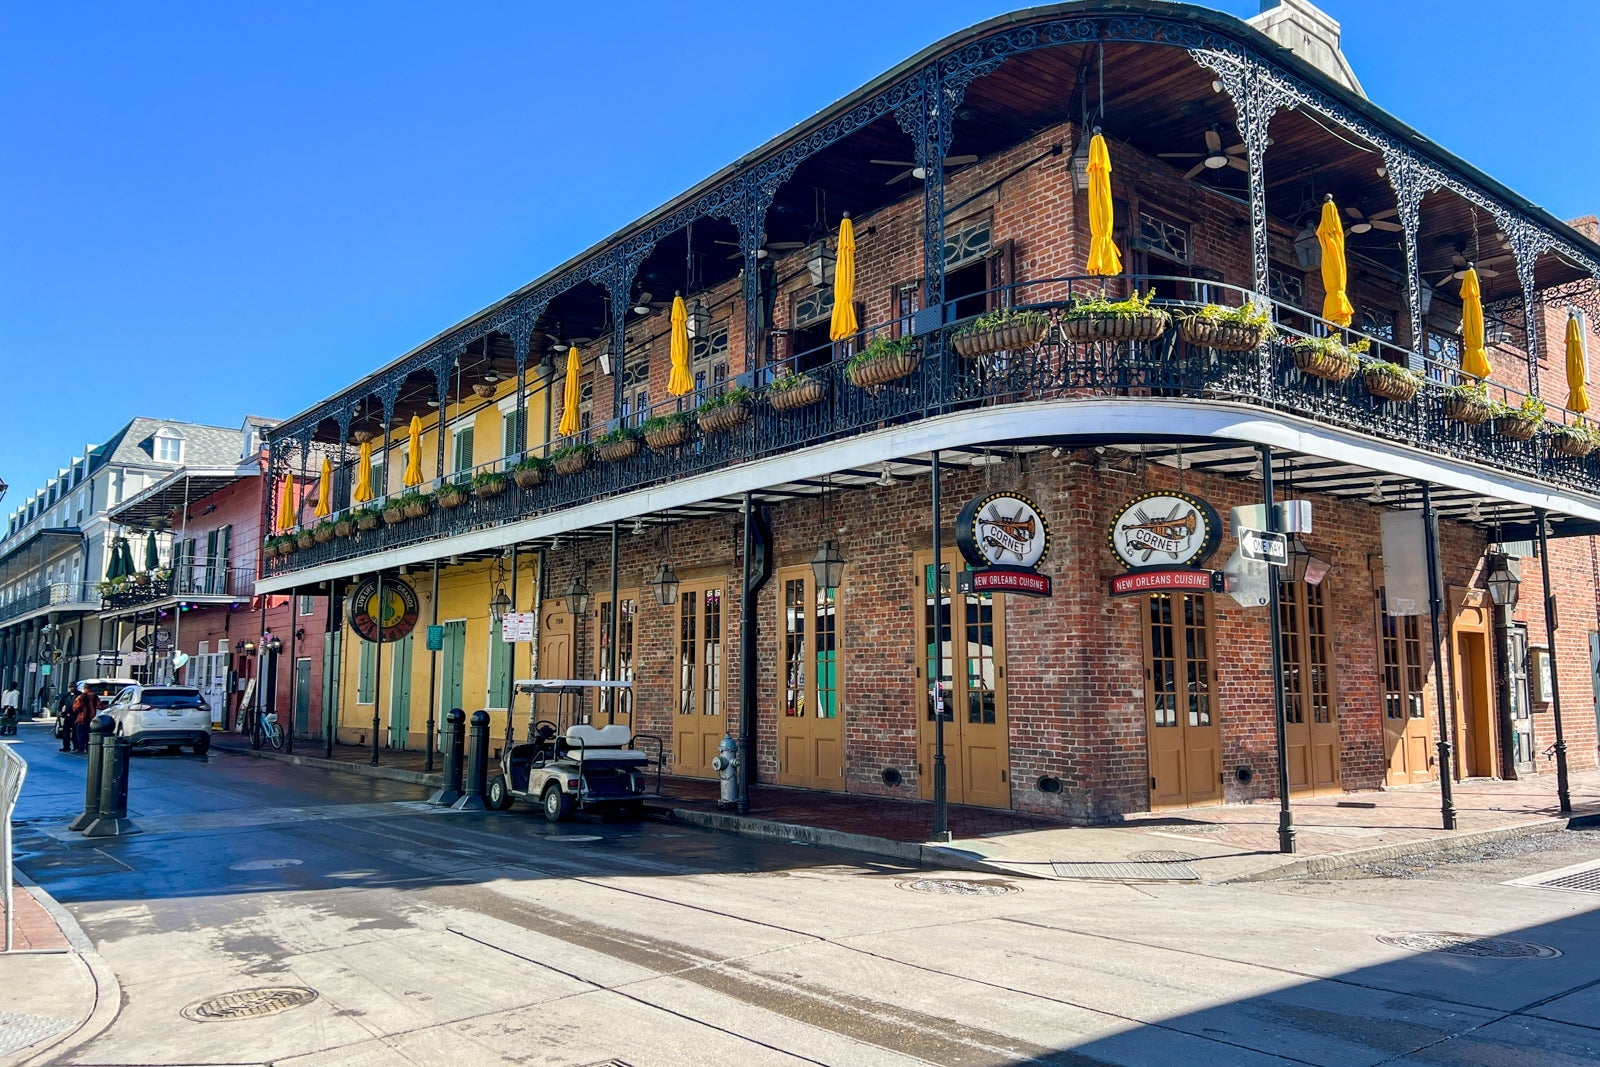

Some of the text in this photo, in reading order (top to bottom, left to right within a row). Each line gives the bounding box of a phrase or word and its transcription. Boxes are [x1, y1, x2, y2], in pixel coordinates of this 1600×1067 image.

[989, 525, 1026, 553] CORNET
[1136, 528, 1181, 552] CORNET
[1253, 538, 1281, 555] ONE WAY
[974, 575, 1044, 591] NEW ORLEANS CUISINE
[1116, 579, 1133, 591] NEW
[1136, 575, 1171, 587] ORLEANS
[1174, 574, 1208, 586] CUISINE
[357, 584, 414, 608] LIVE LIFE GRANDE
